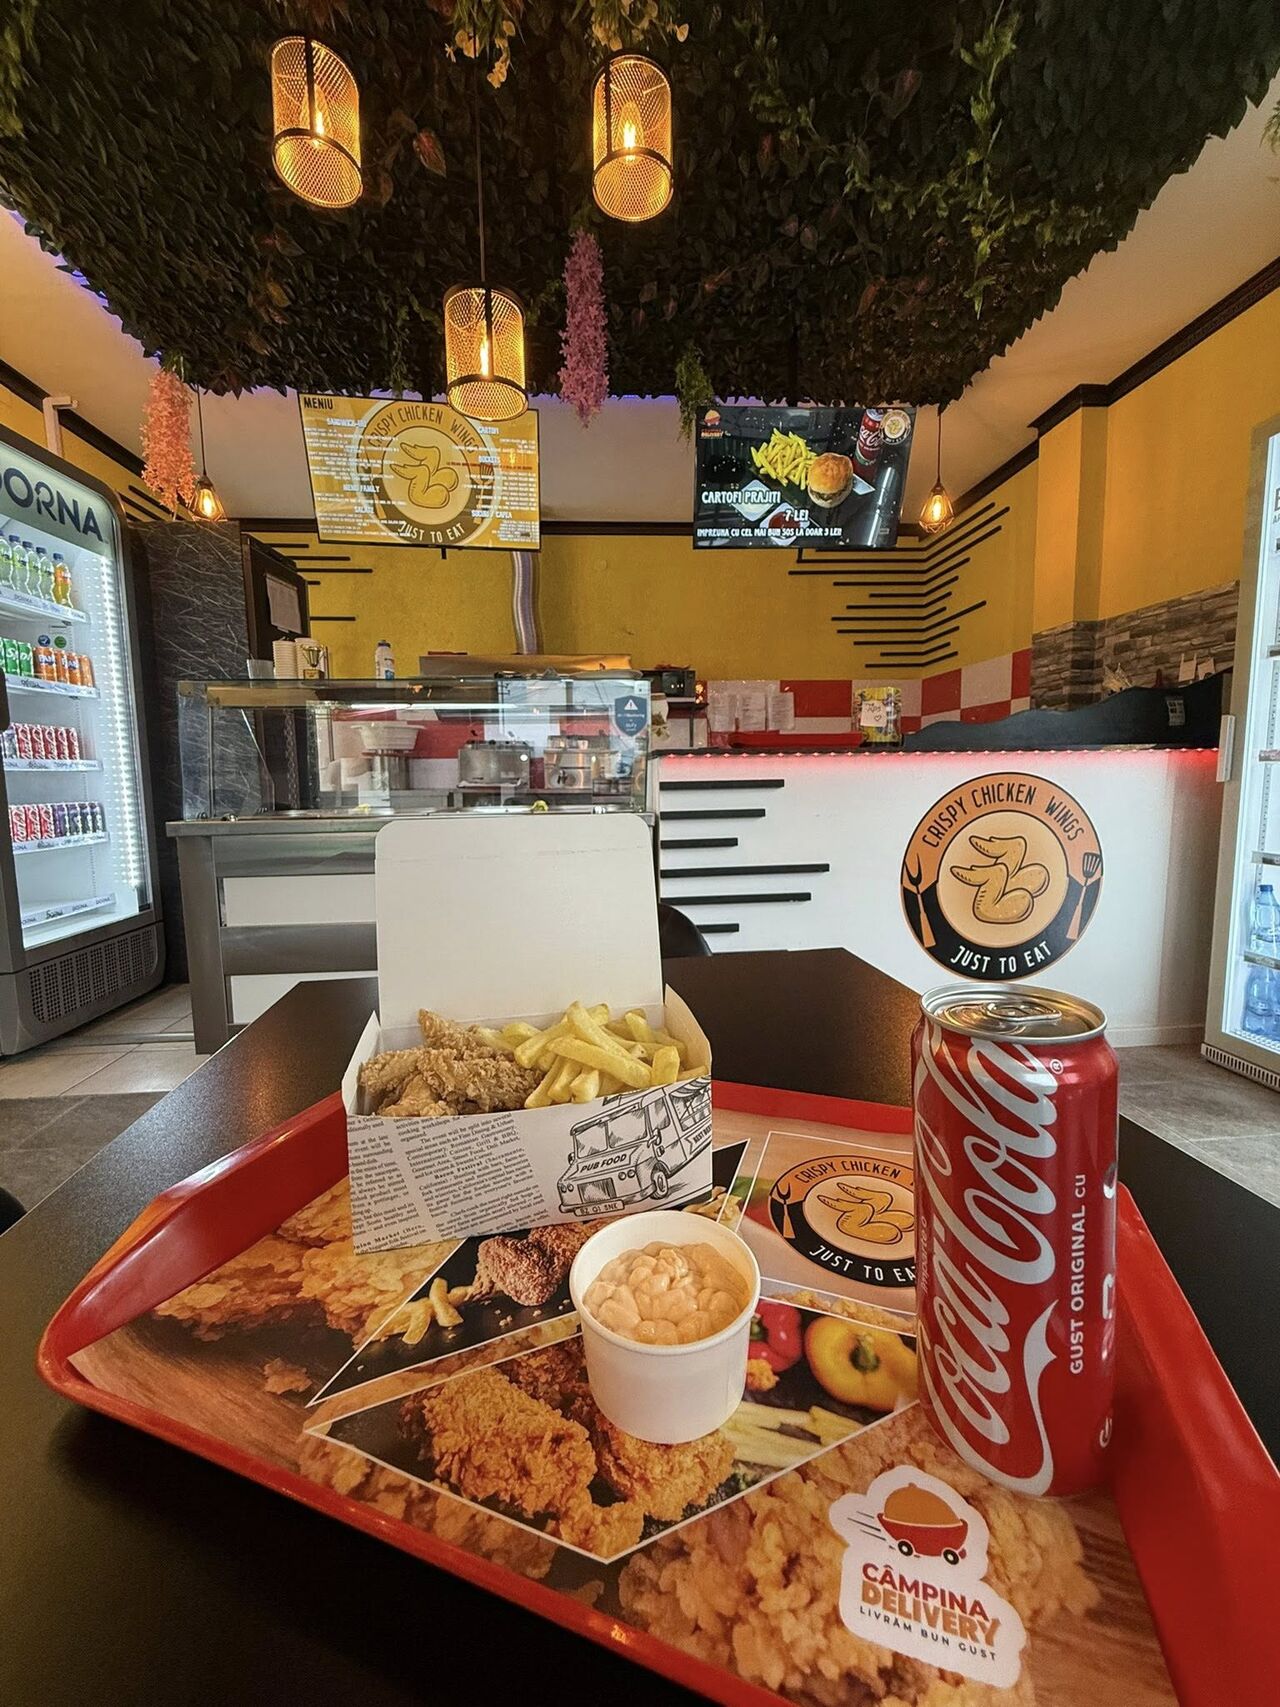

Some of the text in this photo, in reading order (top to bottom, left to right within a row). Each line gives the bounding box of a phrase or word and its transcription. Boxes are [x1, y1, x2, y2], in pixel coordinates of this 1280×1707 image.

[304, 397, 333, 410] MENIU
[368, 412, 398, 447] CRISPY
[397, 405, 444, 424] CHICKEN
[450, 418, 479, 454] WINGS
[0, 468, 103, 542] ORNA
[701, 490, 781, 504] CARTOFI PRAJITI
[794, 509, 809, 521] LEI
[398, 521, 424, 539] JUST
[430, 529, 443, 543] TO
[448, 522, 466, 540] EAT
[731, 528, 740, 536] CU
[741, 528, 753, 536] CEL
[782, 528, 794, 536] SOS
[796, 528, 804, 536] LA
[805, 528, 822, 536] DOAR
[922, 782, 1085, 848] CRISPY CHICKEN WINGS
[950, 941, 1052, 974] JUST TO EAT
[409, 1152, 446, 1166] International
[475, 1138, 490, 1146] Grill
[456, 1160, 482, 1171] Festival
[580, 1153, 627, 1173] PUB FOOD
[794, 1160, 901, 1184] CRISPY CHICKEN
[809, 1245, 853, 1272] JUST
[863, 1265, 884, 1281] TO
[914, 1022, 1059, 1496] Coca-Cola
[1069, 1174, 1086, 1374] GUST ORIGINAL CU
[862, 1562, 990, 1623] CÂMPINA
[861, 1581, 1002, 1647] DELIVERY
[921, 1629, 950, 1647] BUN
[958, 1642, 997, 1661] GUST
